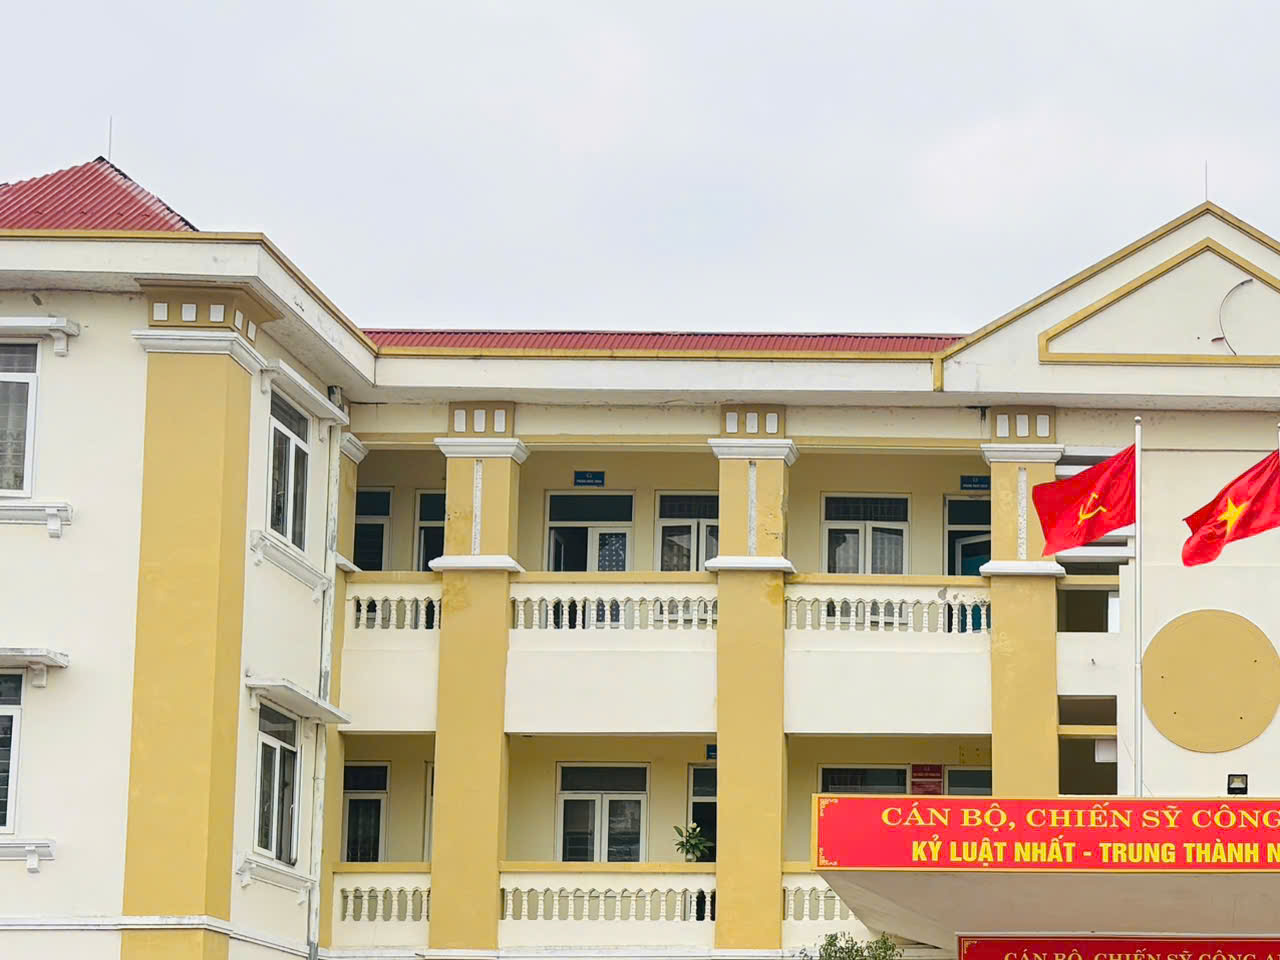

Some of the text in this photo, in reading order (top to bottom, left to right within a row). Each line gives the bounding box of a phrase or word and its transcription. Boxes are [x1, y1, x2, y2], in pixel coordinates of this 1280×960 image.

[881, 802, 950, 826] CÁN
[961, 803, 1016, 832] BỘ,
[1026, 802, 1132, 828] CHIẾN
[1142, 805, 1183, 828] SỸ
[911, 834, 943, 861] KỶ
[950, 837, 1007, 867] LUẬT
[1014, 834, 1077, 863] NHẤT
[1099, 842, 1176, 863] TRUNG
[1183, 838, 1260, 863] THÀNH
